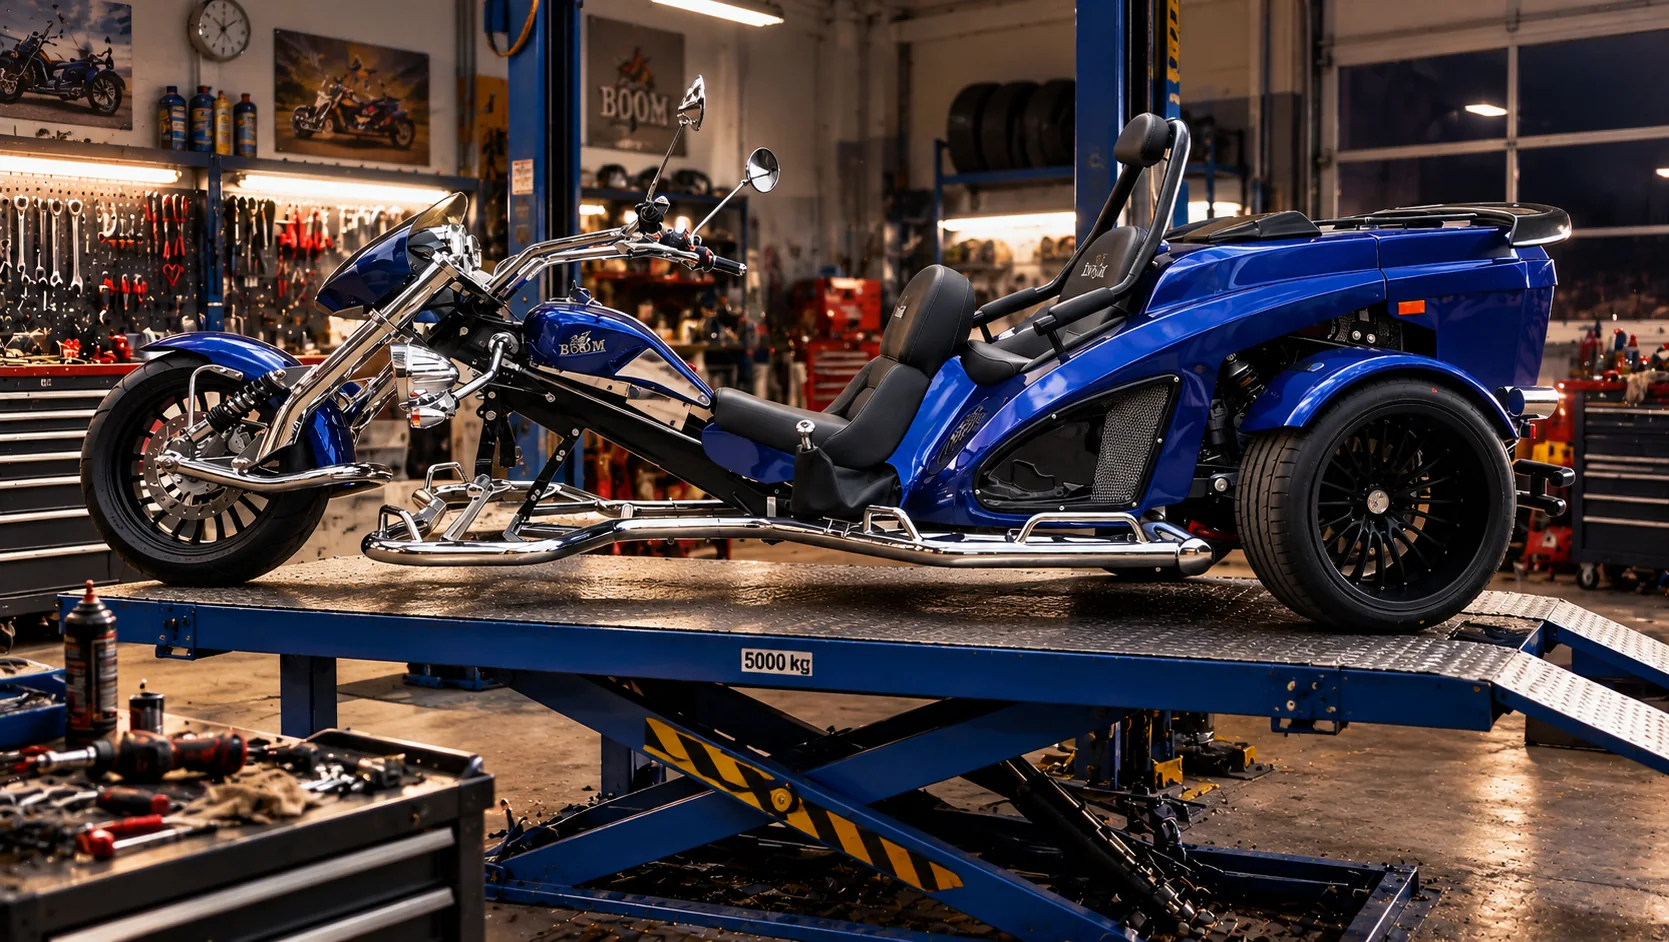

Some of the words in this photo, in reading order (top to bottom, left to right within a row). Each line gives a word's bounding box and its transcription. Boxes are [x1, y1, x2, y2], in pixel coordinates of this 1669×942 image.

[600, 86, 668, 126] BOOM
[559, 339, 606, 355] BOOM
[745, 651, 786, 671] 5000
[790, 654, 810, 675] kg
